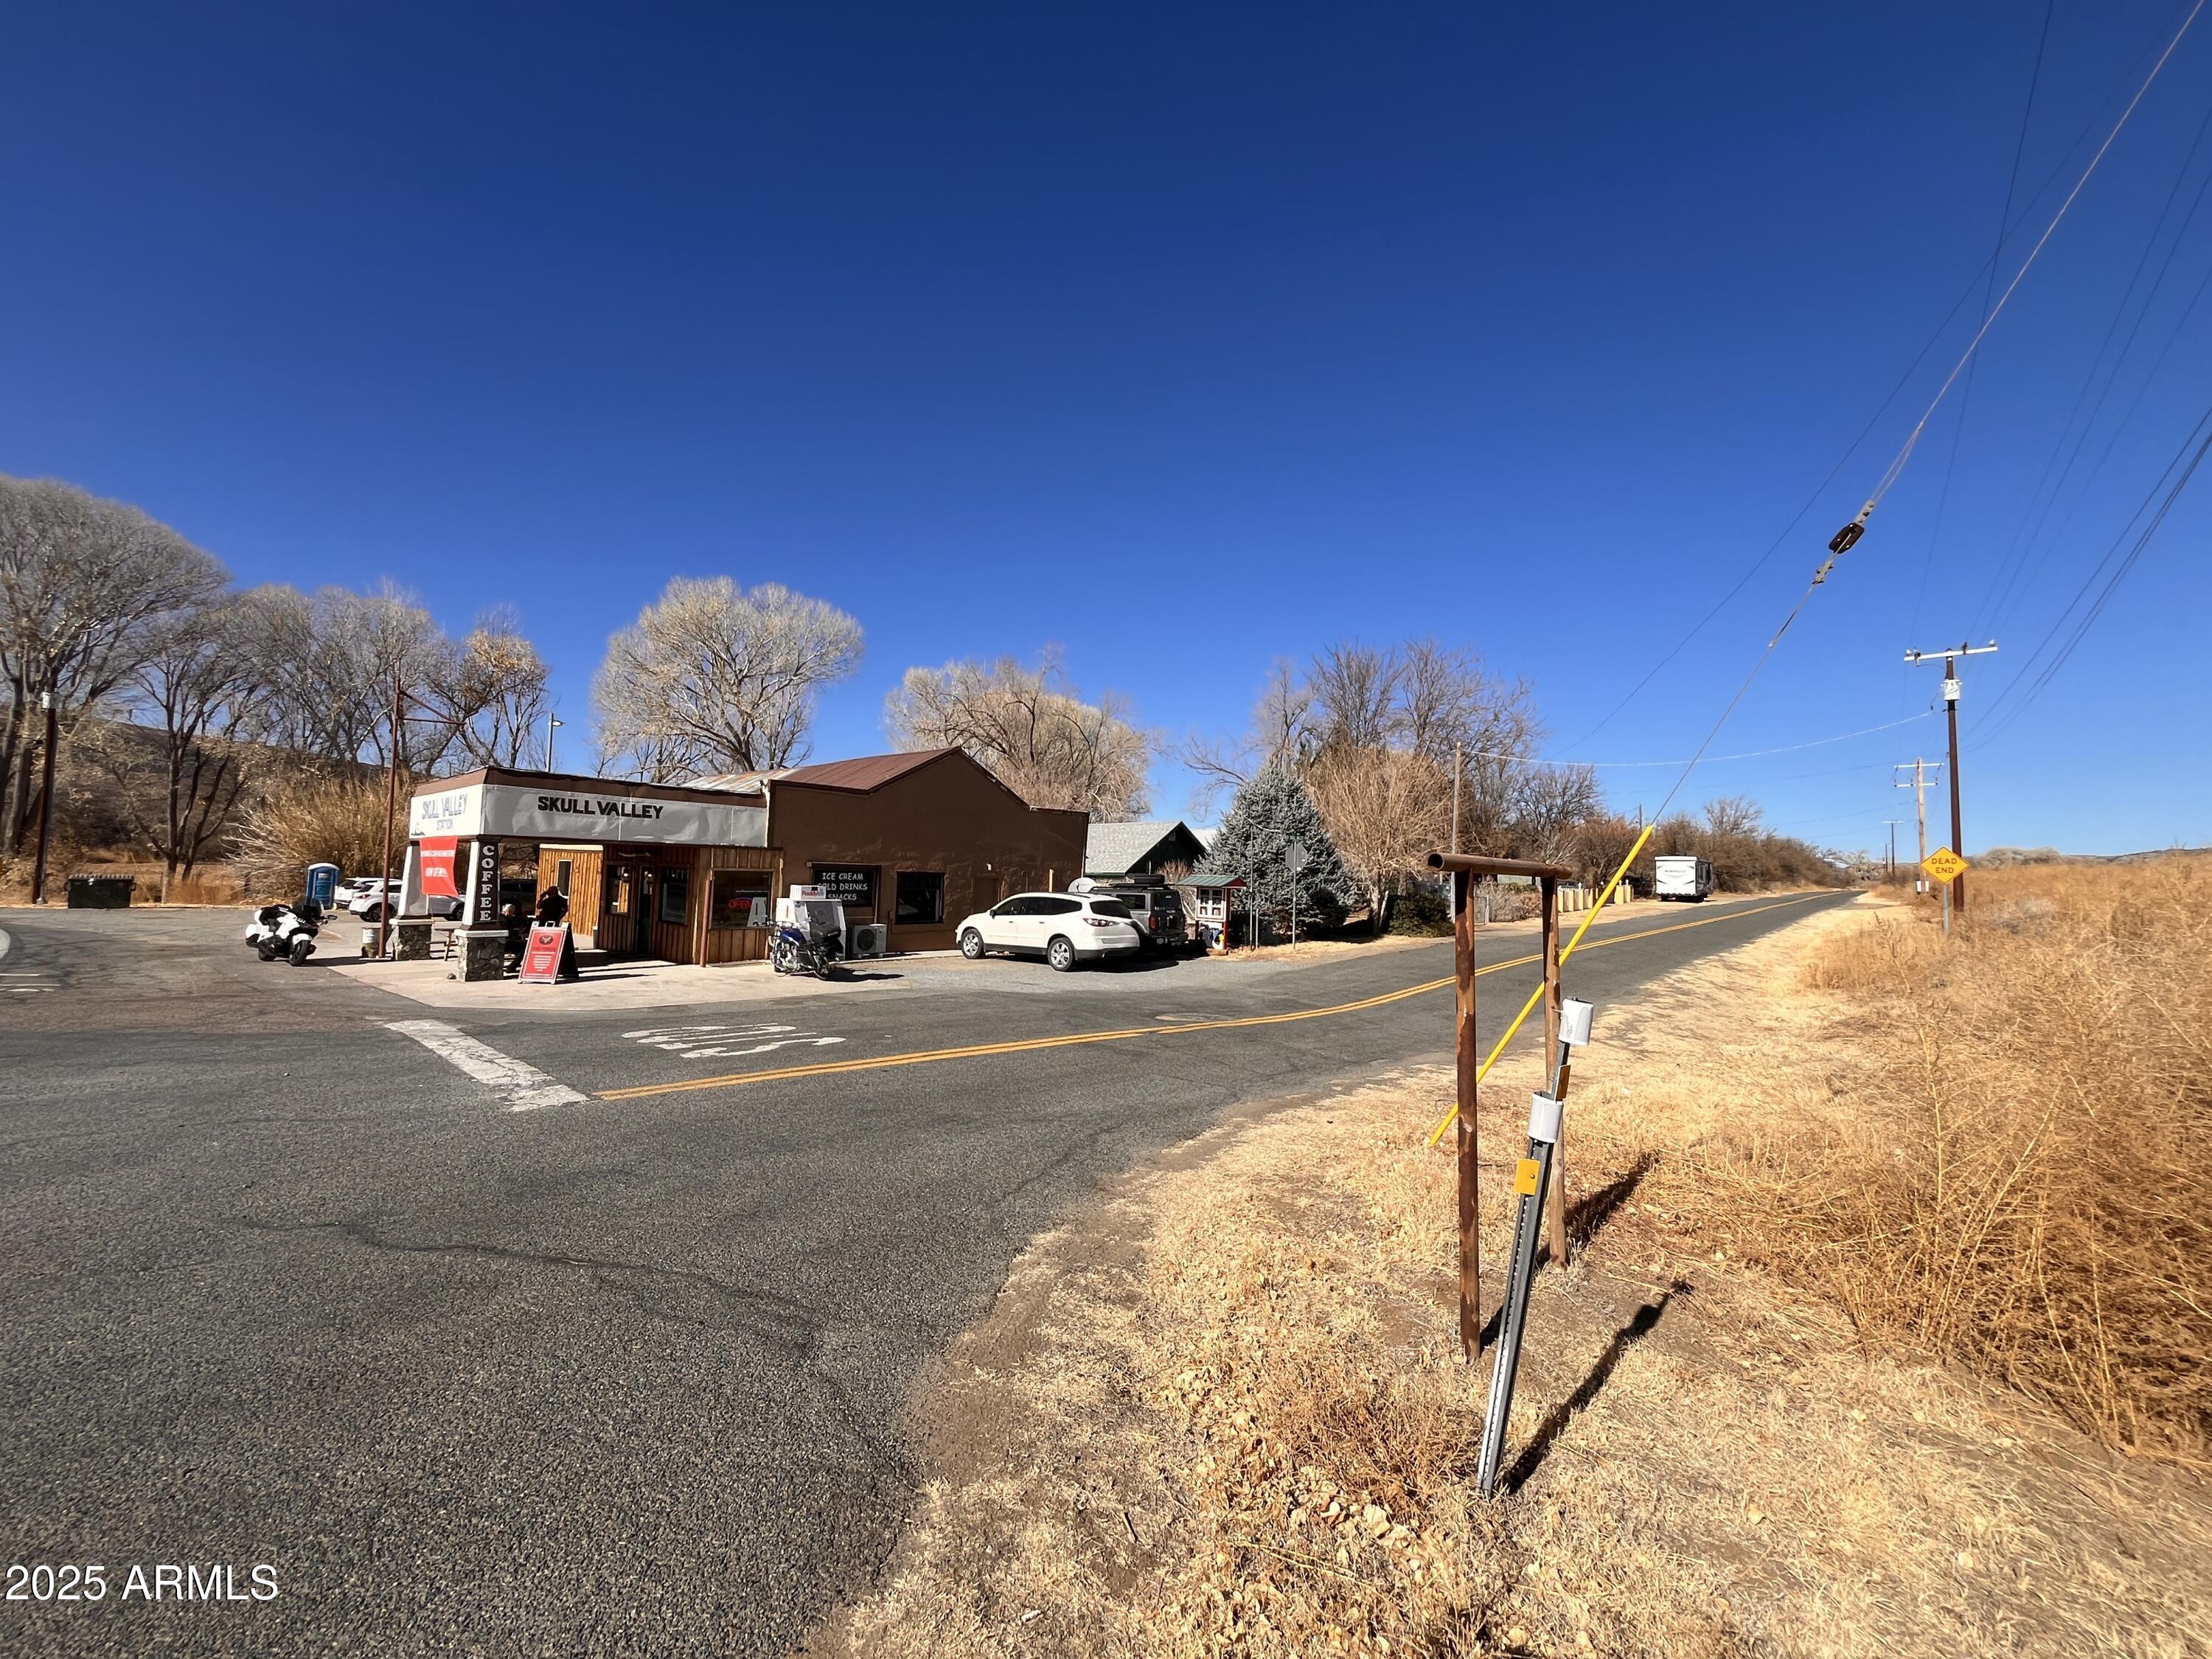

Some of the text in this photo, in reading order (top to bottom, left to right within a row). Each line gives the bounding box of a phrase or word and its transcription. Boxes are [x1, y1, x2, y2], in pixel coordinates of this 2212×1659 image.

[441, 793, 469, 817] VALLEY
[538, 796, 664, 819] SKULL VALLEY
[479, 845, 495, 921] COFFEE
[817, 883, 868, 891] OLD DRINKS
[822, 872, 863, 880] ICE CREAM
[621, 1023, 846, 1058] STOP
